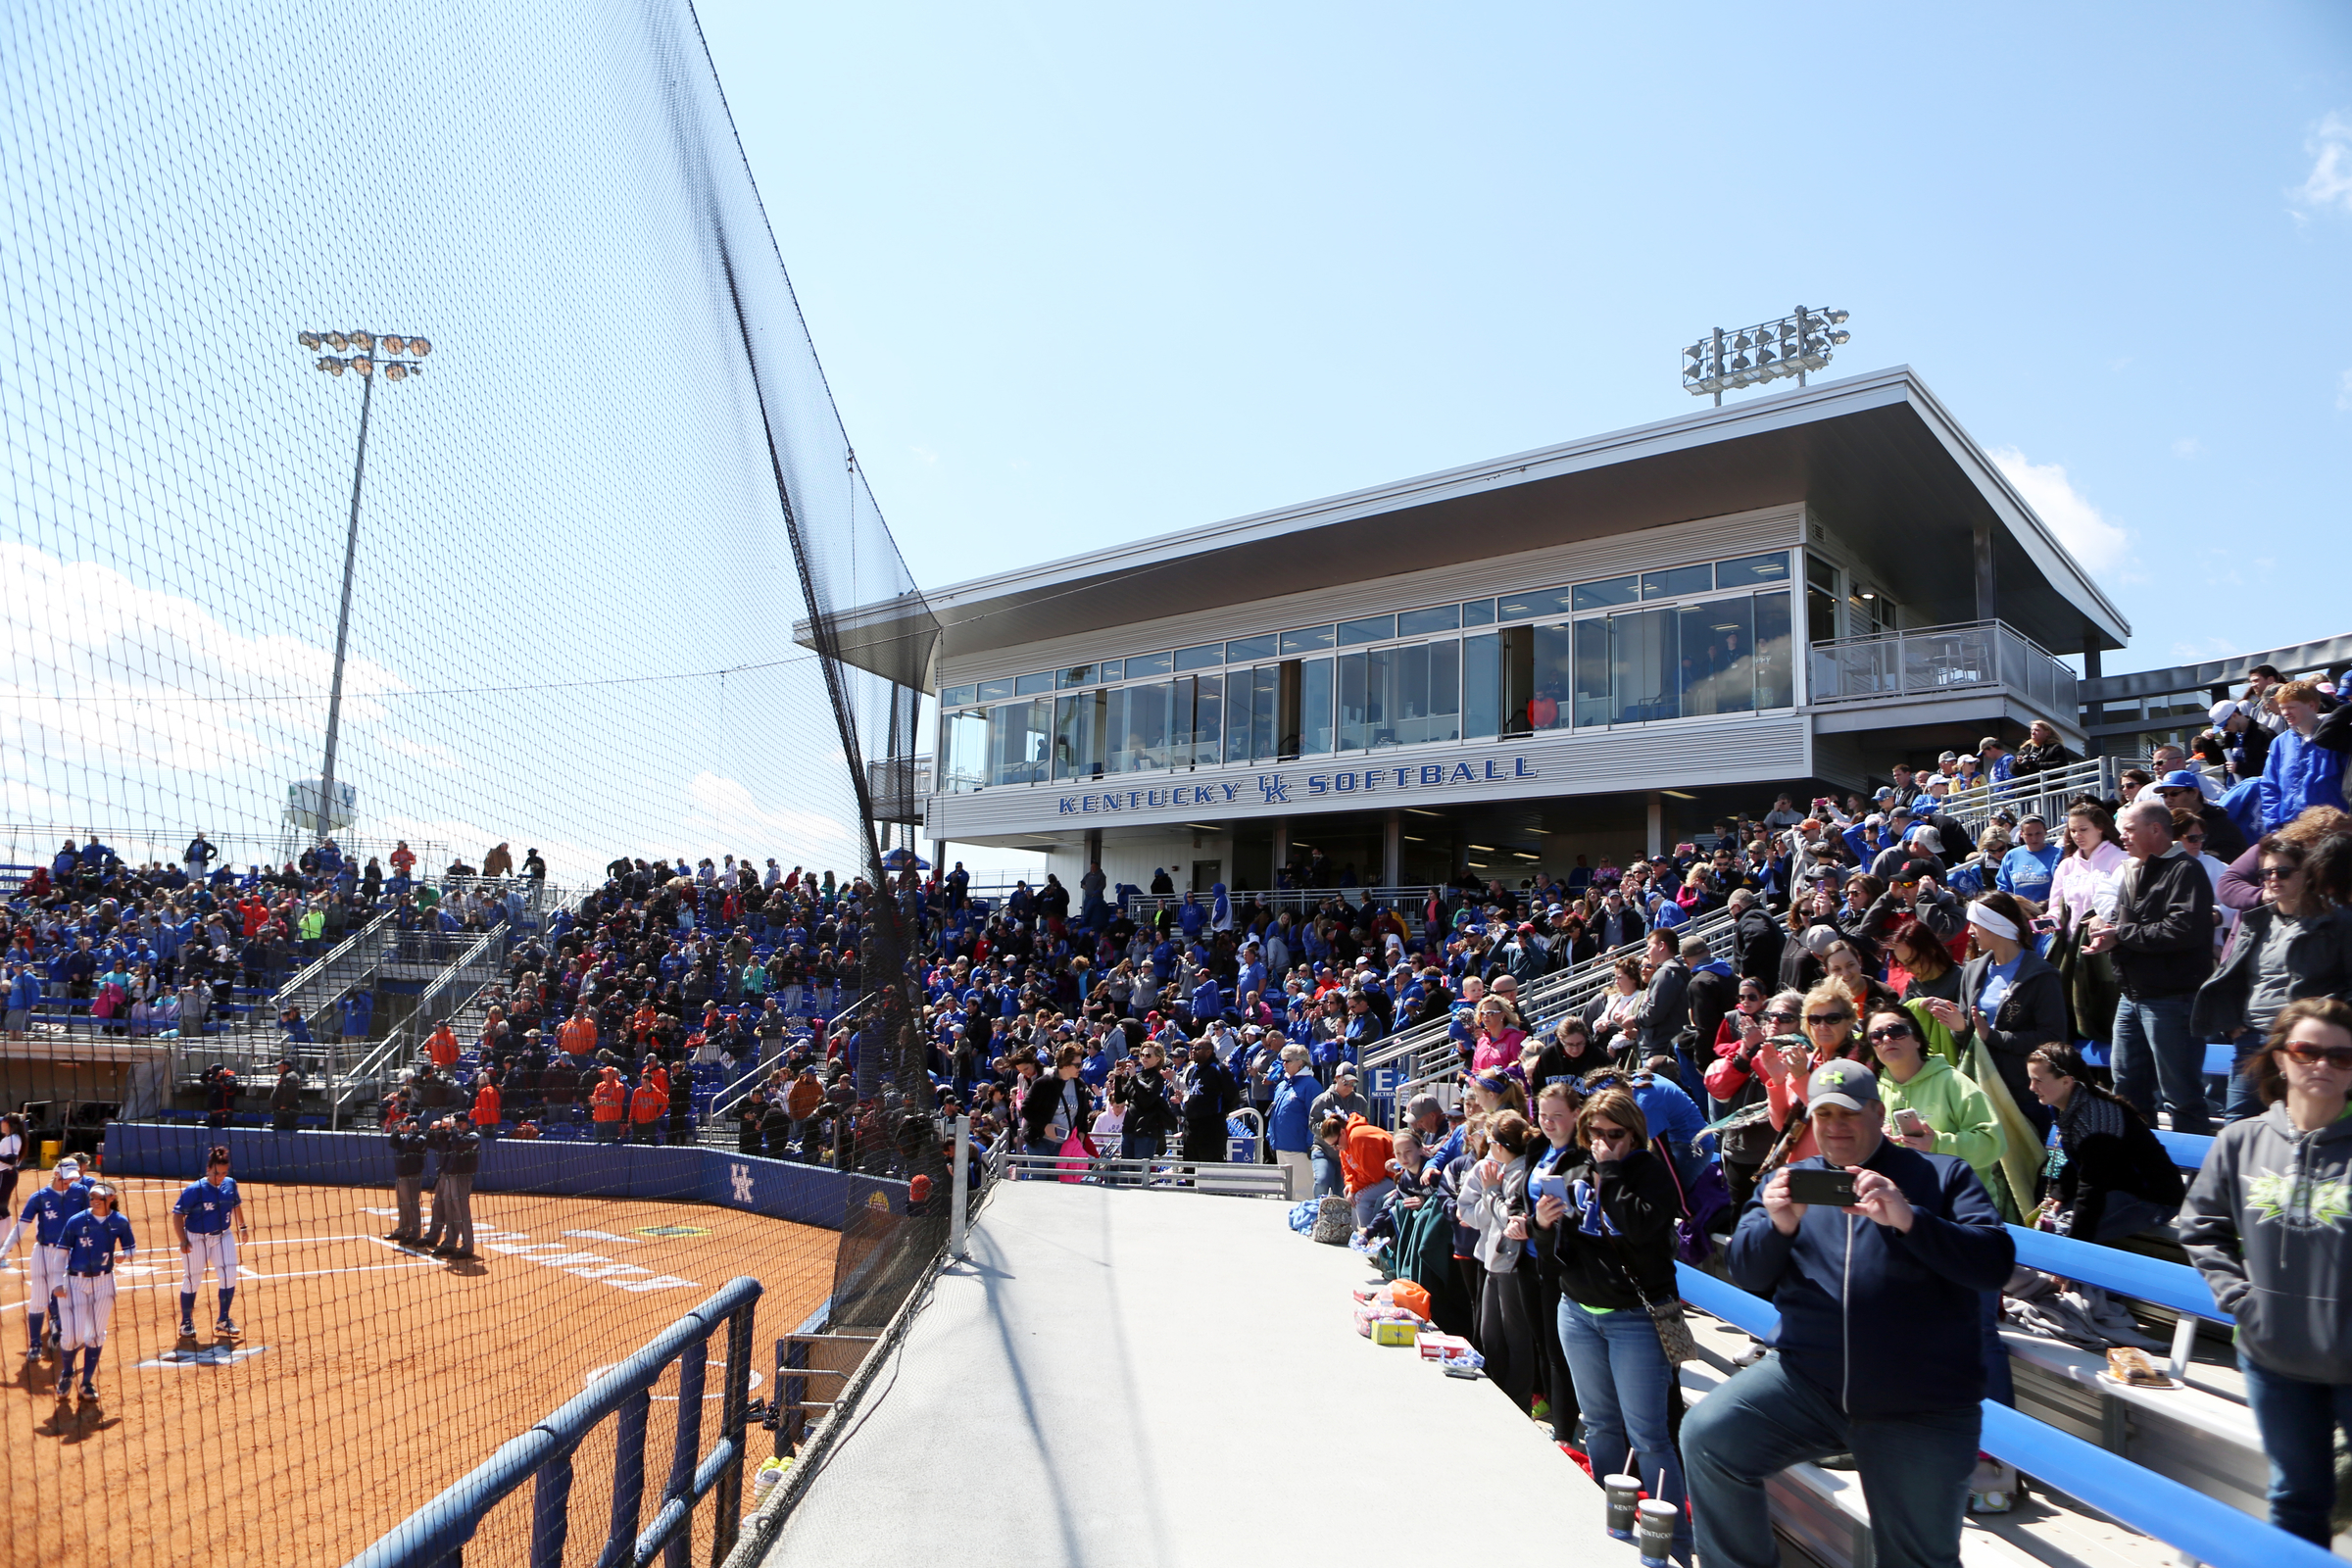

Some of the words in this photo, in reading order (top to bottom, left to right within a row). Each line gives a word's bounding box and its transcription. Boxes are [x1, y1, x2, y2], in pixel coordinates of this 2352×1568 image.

[1058, 781, 1241, 814] KENTUCKY
[1257, 774, 1291, 804] UK
[1308, 756, 1538, 796] SOFTBALL
[1376, 1069, 1393, 1091] E
[1227, 1140, 1244, 1161] F
[731, 1163, 755, 1203] UK
[101, 1252, 110, 1266] 7
